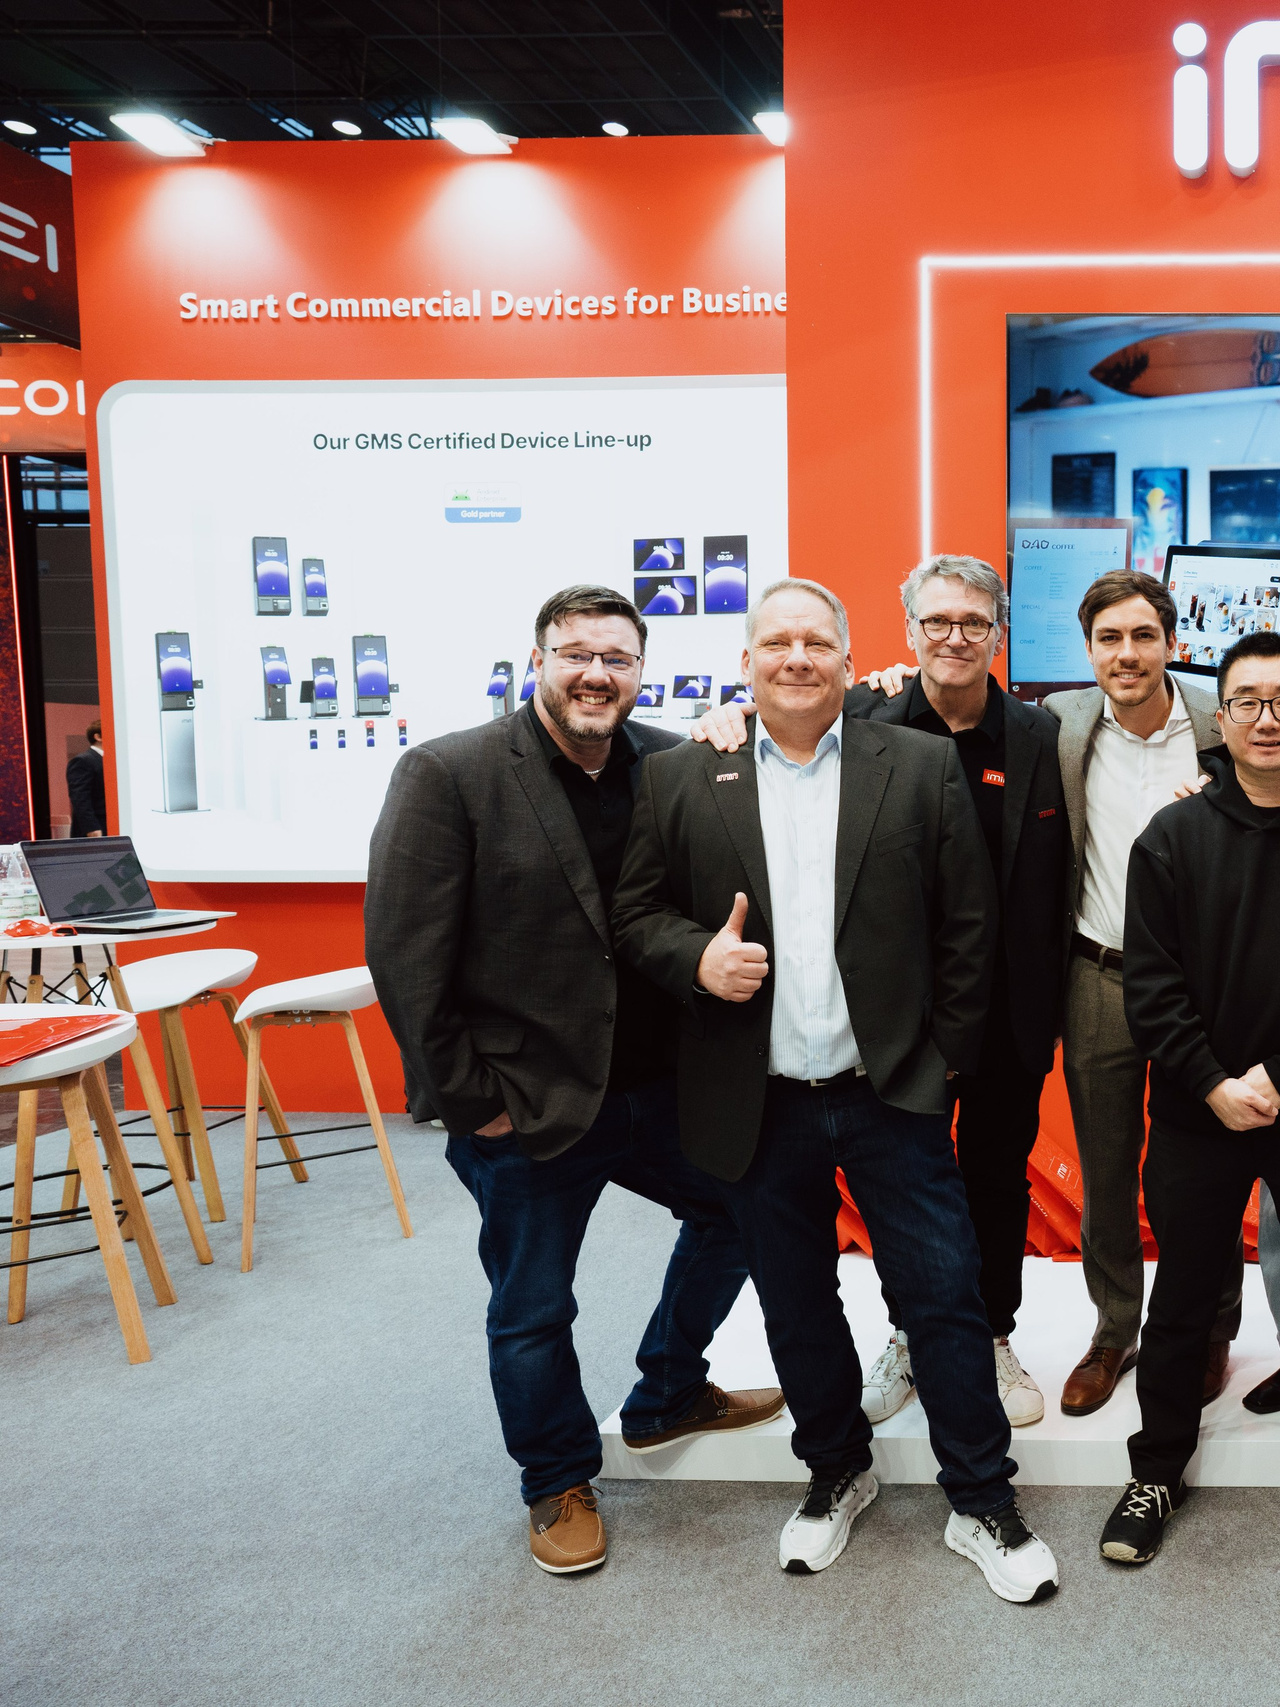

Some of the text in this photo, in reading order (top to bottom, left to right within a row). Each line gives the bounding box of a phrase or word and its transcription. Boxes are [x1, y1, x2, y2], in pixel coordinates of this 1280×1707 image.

[179, 292, 279, 319] Smart
[286, 289, 481, 318] Commercial
[490, 289, 616, 317] Devices
[624, 287, 674, 315] for
[313, 430, 652, 451] Our GMS Certified Device Line-up
[461, 510, 506, 519] Gold partner
